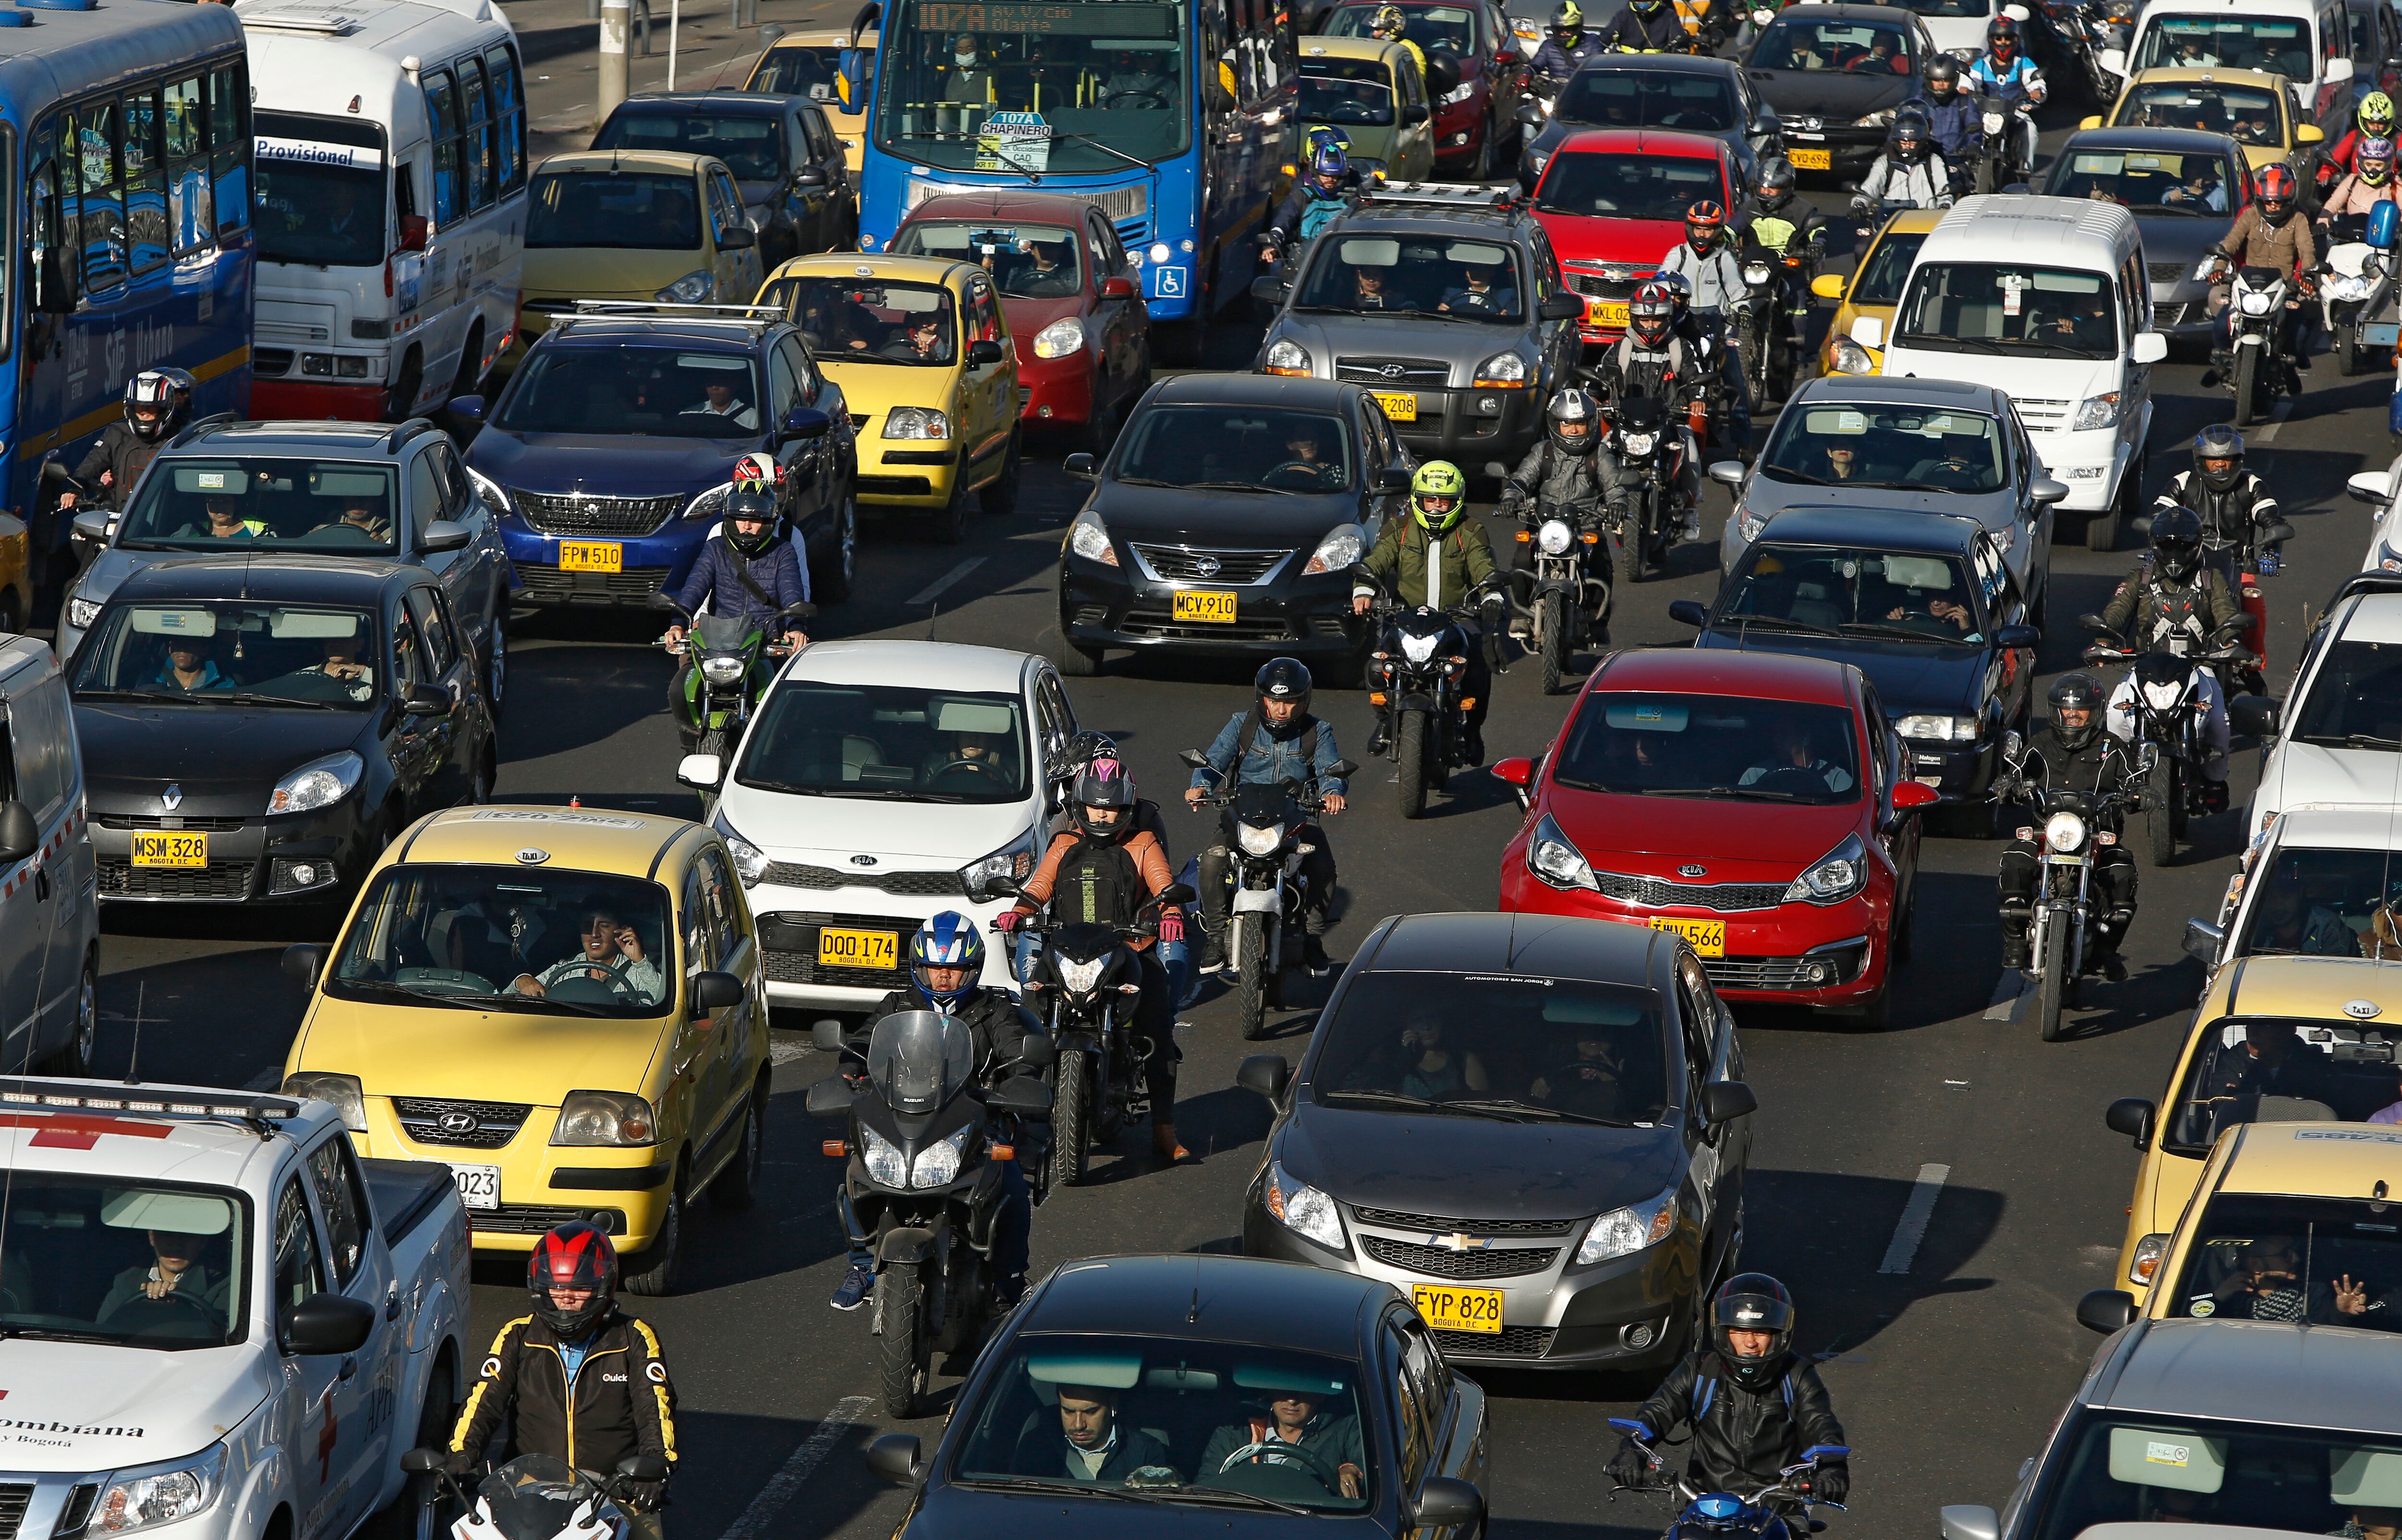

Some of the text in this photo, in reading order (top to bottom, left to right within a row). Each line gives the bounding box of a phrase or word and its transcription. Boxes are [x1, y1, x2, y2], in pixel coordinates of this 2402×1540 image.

[918, 3, 985, 31] 107A
[1000, 113, 1034, 124] 107A
[981, 123, 1050, 136] CHAPINERO
[257, 140, 354, 166] Provisional
[1616, 308, 1630, 320] 02
[136, 315, 173, 368] Urbano
[1390, 399, 1413, 413] 208
[562, 547, 619, 564] FPW 510
[1176, 596, 1234, 613] MCV 910
[557, 816, 627, 826] SMZ
[134, 837, 205, 858] MSM 328
[522, 852, 537, 860] TAXI
[1682, 866, 1703, 874] KIA
[1689, 927, 1722, 947] 566
[822, 934, 894, 958] DQO 174
[2353, 1006, 2369, 1014] TAXI
[457, 1172, 495, 1196] 023
[1415, 1291, 1499, 1320] FYP 828
[1433, 1318, 1479, 1329] BOGOTA D.C.
[602, 1373, 628, 1382] Quick
[365, 1360, 394, 1442] APH
[16, 1434, 72, 1448] Bogotá
